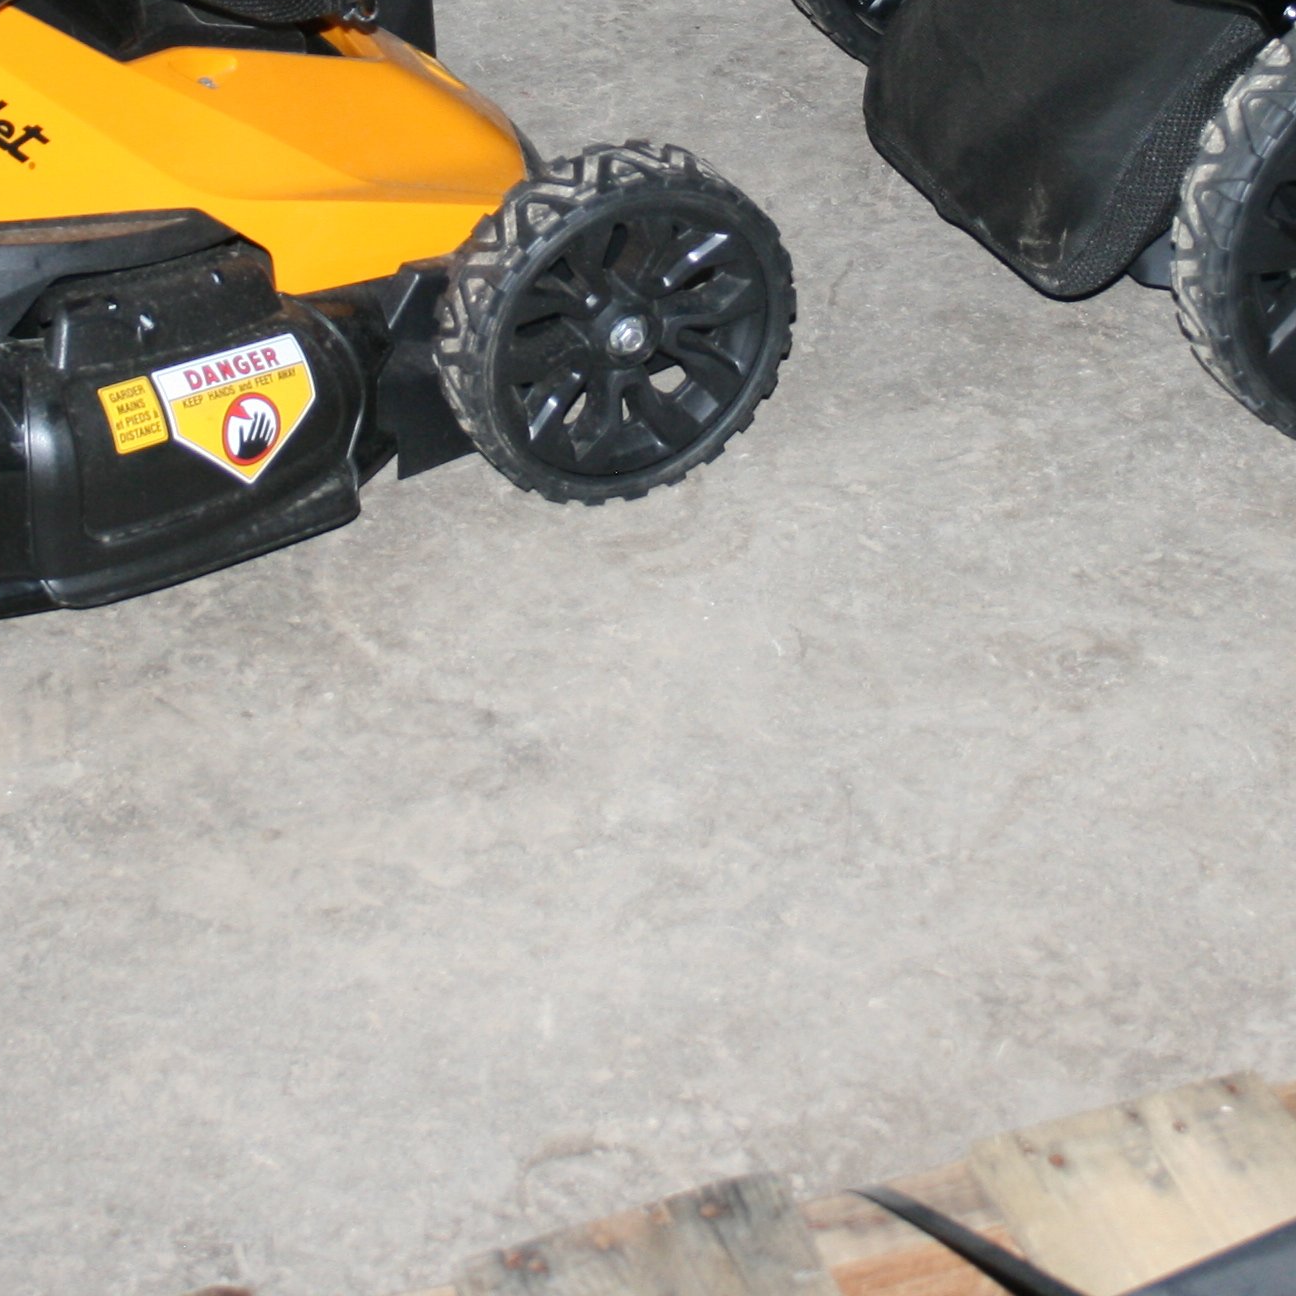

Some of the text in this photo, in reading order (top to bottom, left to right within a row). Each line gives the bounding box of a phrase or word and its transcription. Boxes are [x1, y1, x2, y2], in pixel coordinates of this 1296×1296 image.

[183, 346, 281, 391] DANGER
[108, 384, 146, 404] GARDER
[183, 367, 296, 409] KEEP HANDS and FEET AWAY
[116, 398, 146, 415] MAINS
[115, 419, 124, 431] et
[125, 410, 152, 427] PIEDS
[119, 421, 163, 444] DISTANCE
